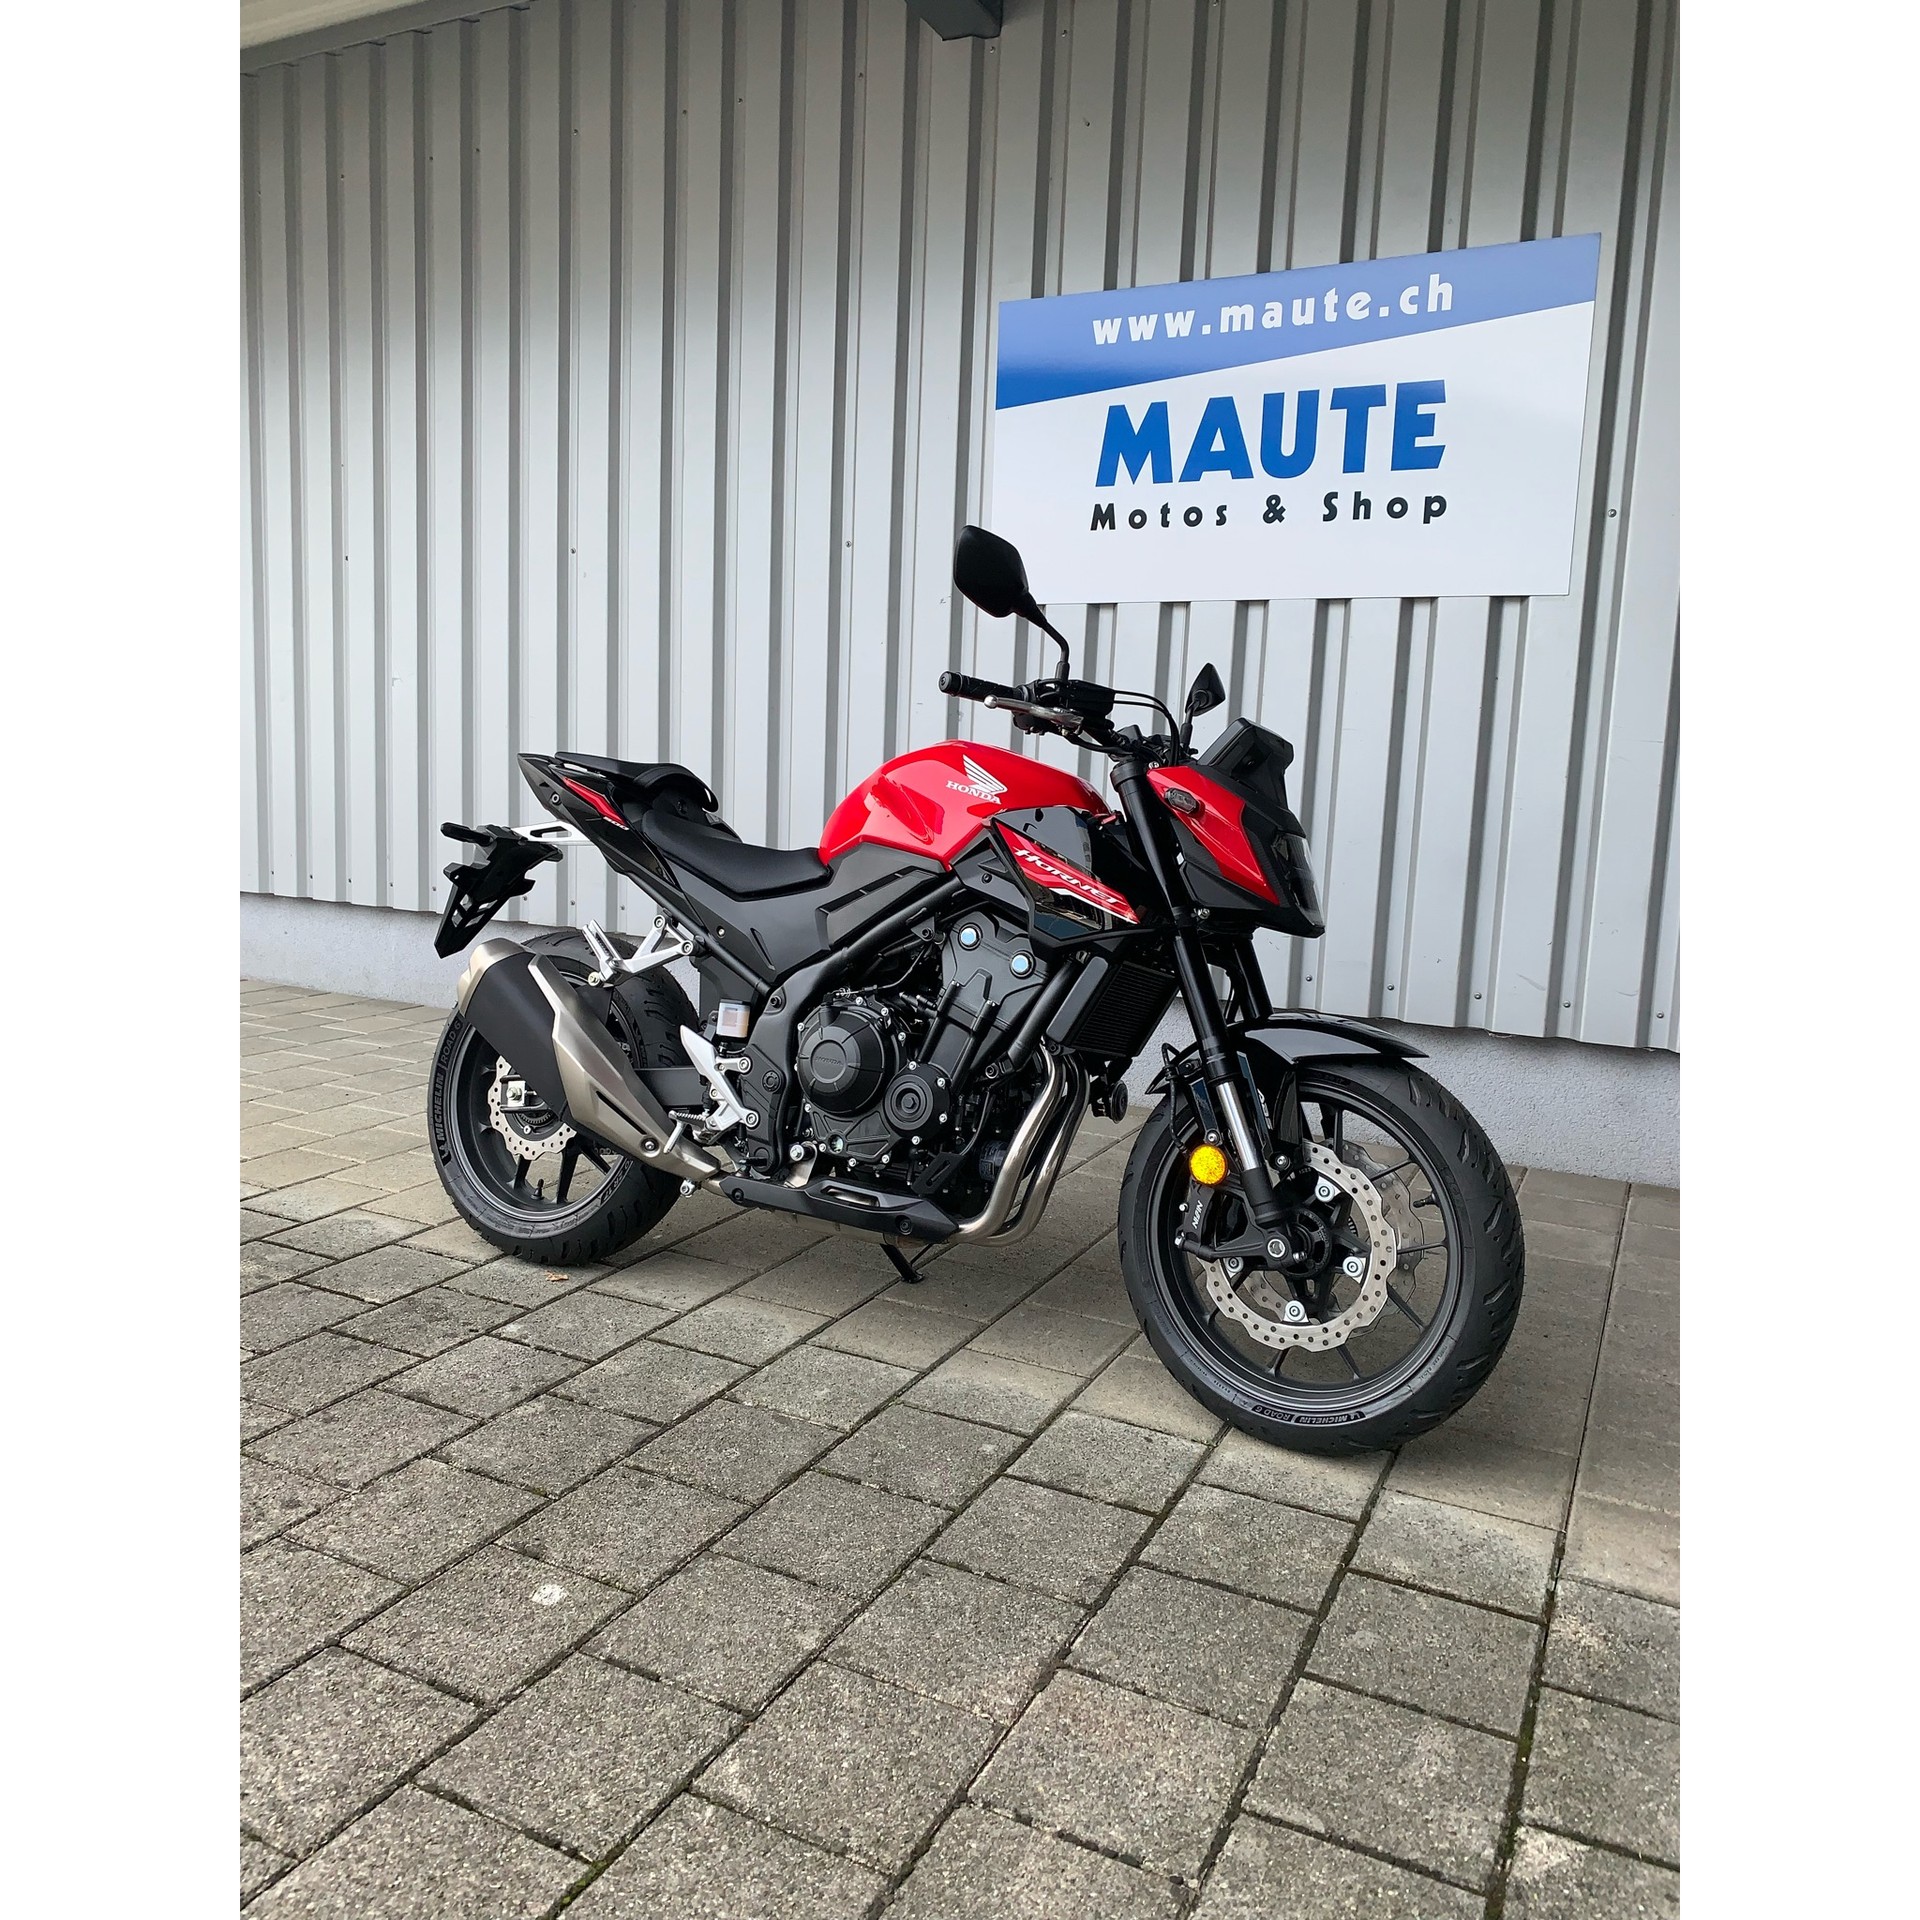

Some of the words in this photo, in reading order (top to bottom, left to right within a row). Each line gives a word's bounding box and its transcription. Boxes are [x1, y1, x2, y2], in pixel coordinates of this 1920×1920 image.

[1092, 273, 1453, 345] www.maute.ch
[1095, 379, 1447, 488] MAUTE
[1090, 502, 1228, 531] Motos
[1262, 494, 1286, 524] &
[1322, 490, 1448, 525] Shop
[945, 780, 1002, 805] HONDA
[440, 1030, 456, 1064] ROAD
[434, 1072, 447, 1141] MICHELIN
[1264, 1409, 1291, 1420] ROAD
[1299, 1414, 1349, 1424] MICHELIN
